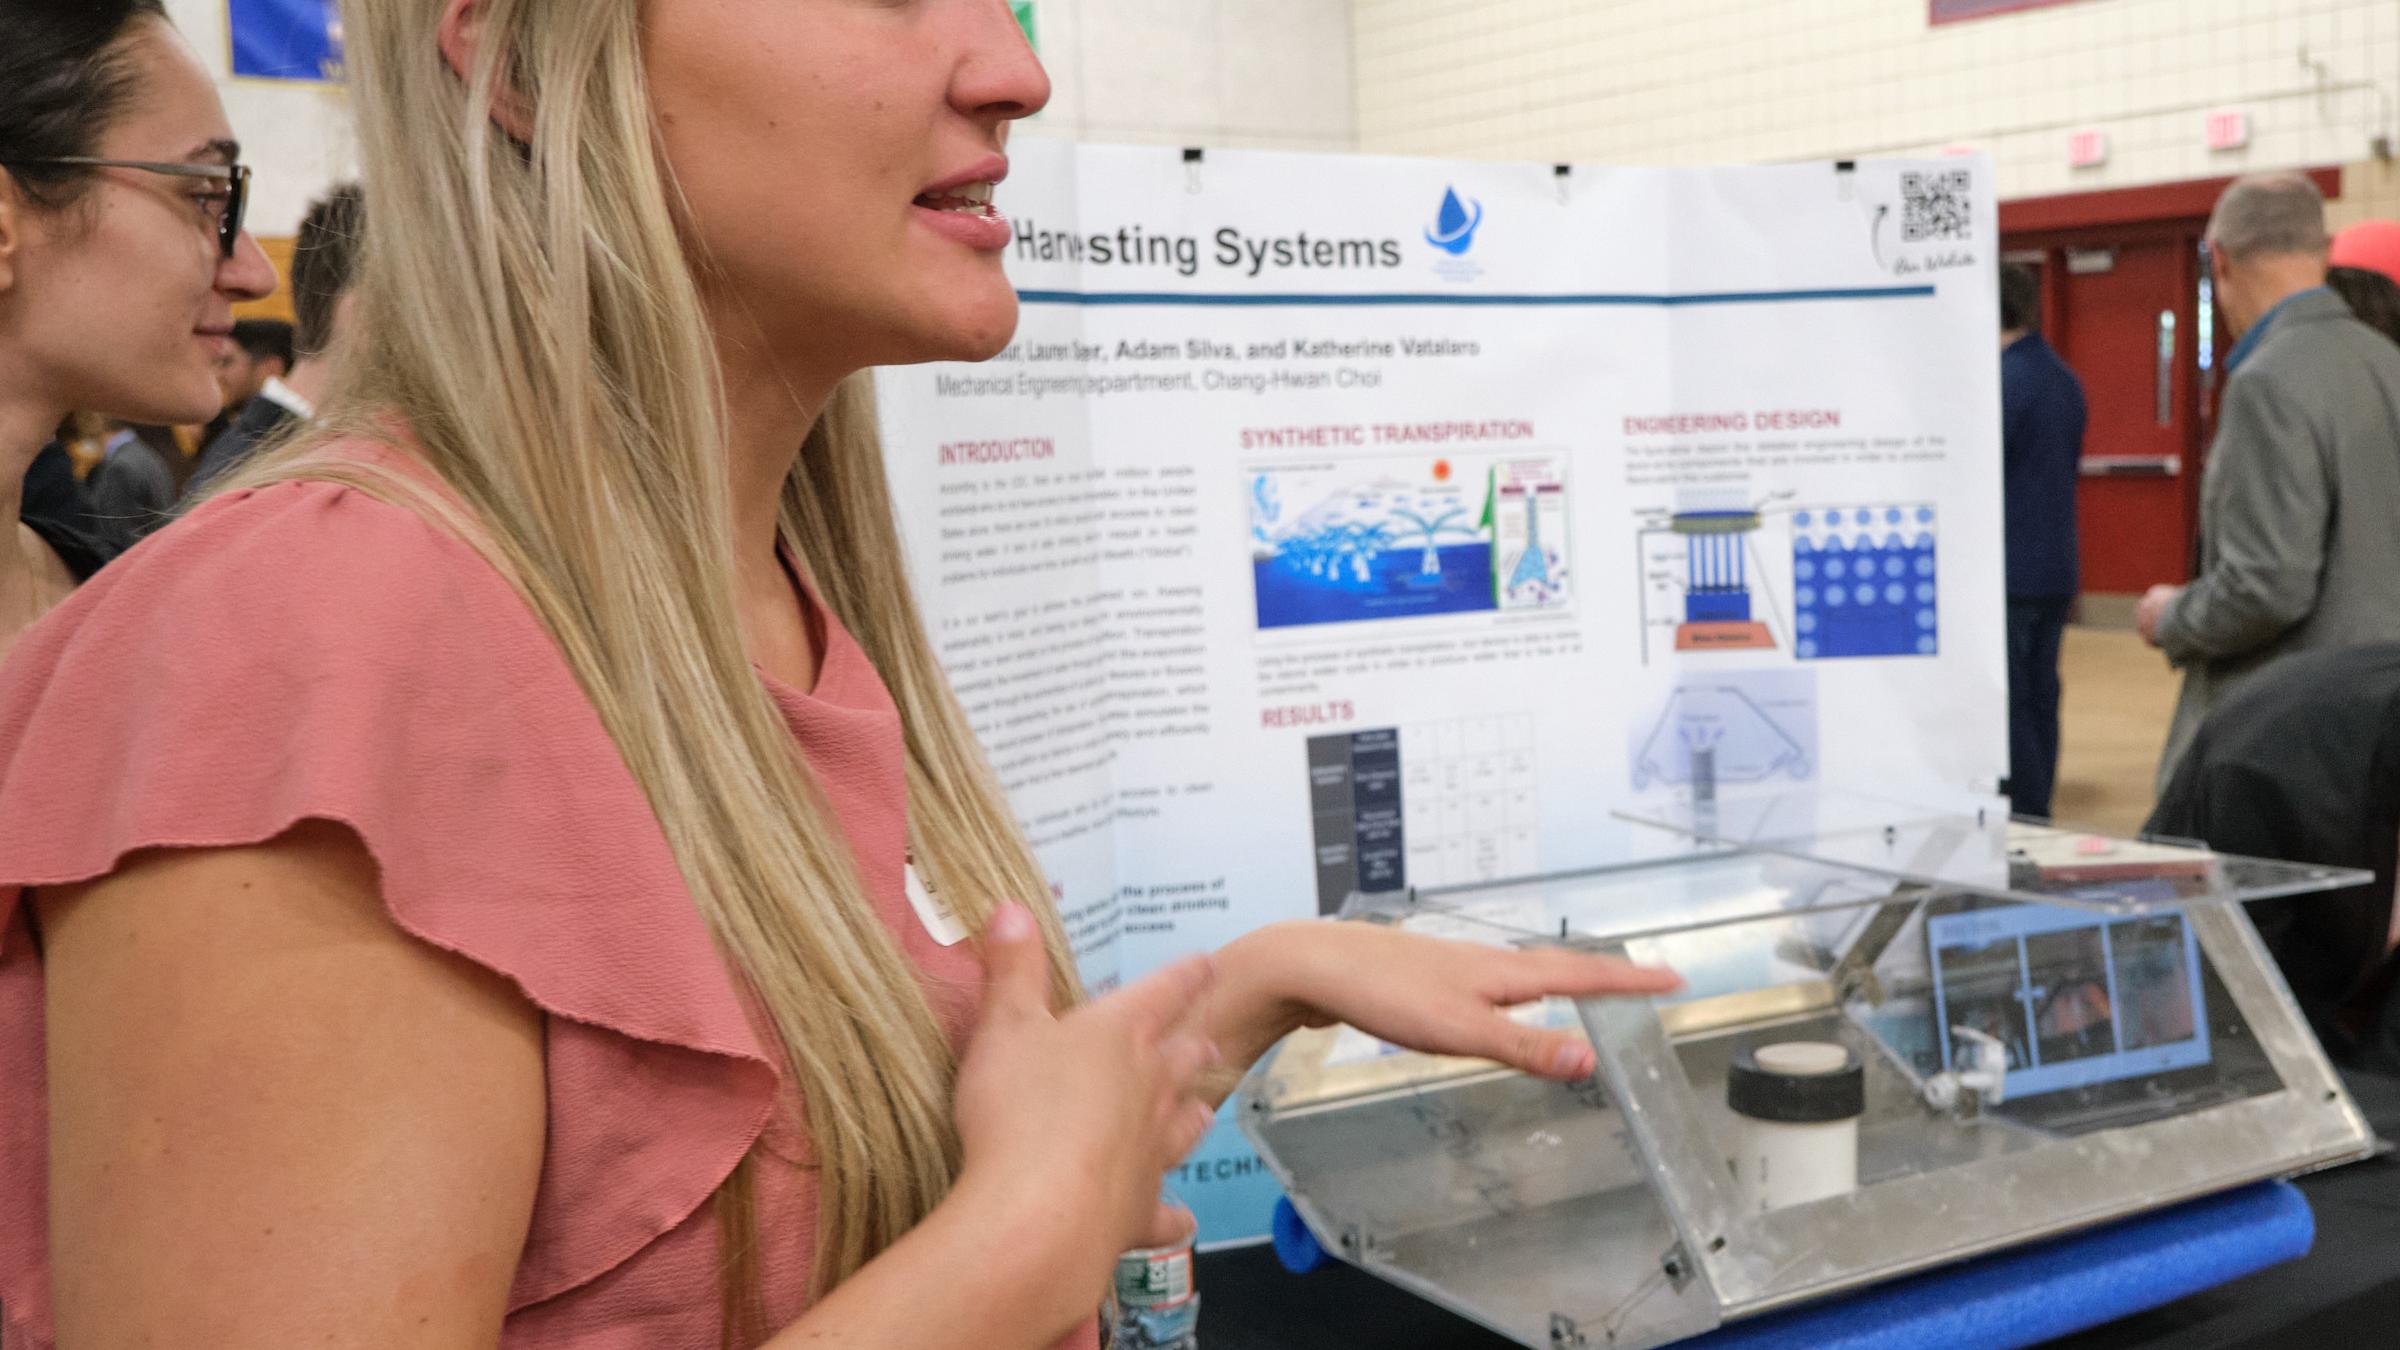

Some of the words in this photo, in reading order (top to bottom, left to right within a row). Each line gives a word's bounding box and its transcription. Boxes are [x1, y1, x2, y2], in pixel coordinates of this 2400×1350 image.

[1214, 228, 1402, 277] Systems
[1116, 340, 1180, 360] Adam
[1186, 340, 1241, 361] Silva,
[1247, 339, 1286, 360] and
[1293, 337, 1394, 358] Katherine
[936, 373, 1012, 397] Mechanical
[1202, 368, 1331, 395] Chang-Hwan
[1336, 367, 1381, 388] Choi
[1239, 424, 1365, 449] SYNTHETIC
[1371, 420, 1535, 445] TRANSPIRATION
[1754, 410, 1841, 432] DESIGN
[938, 437, 1056, 466] INTRODUCTION
[1260, 701, 1355, 729] RESULTS
